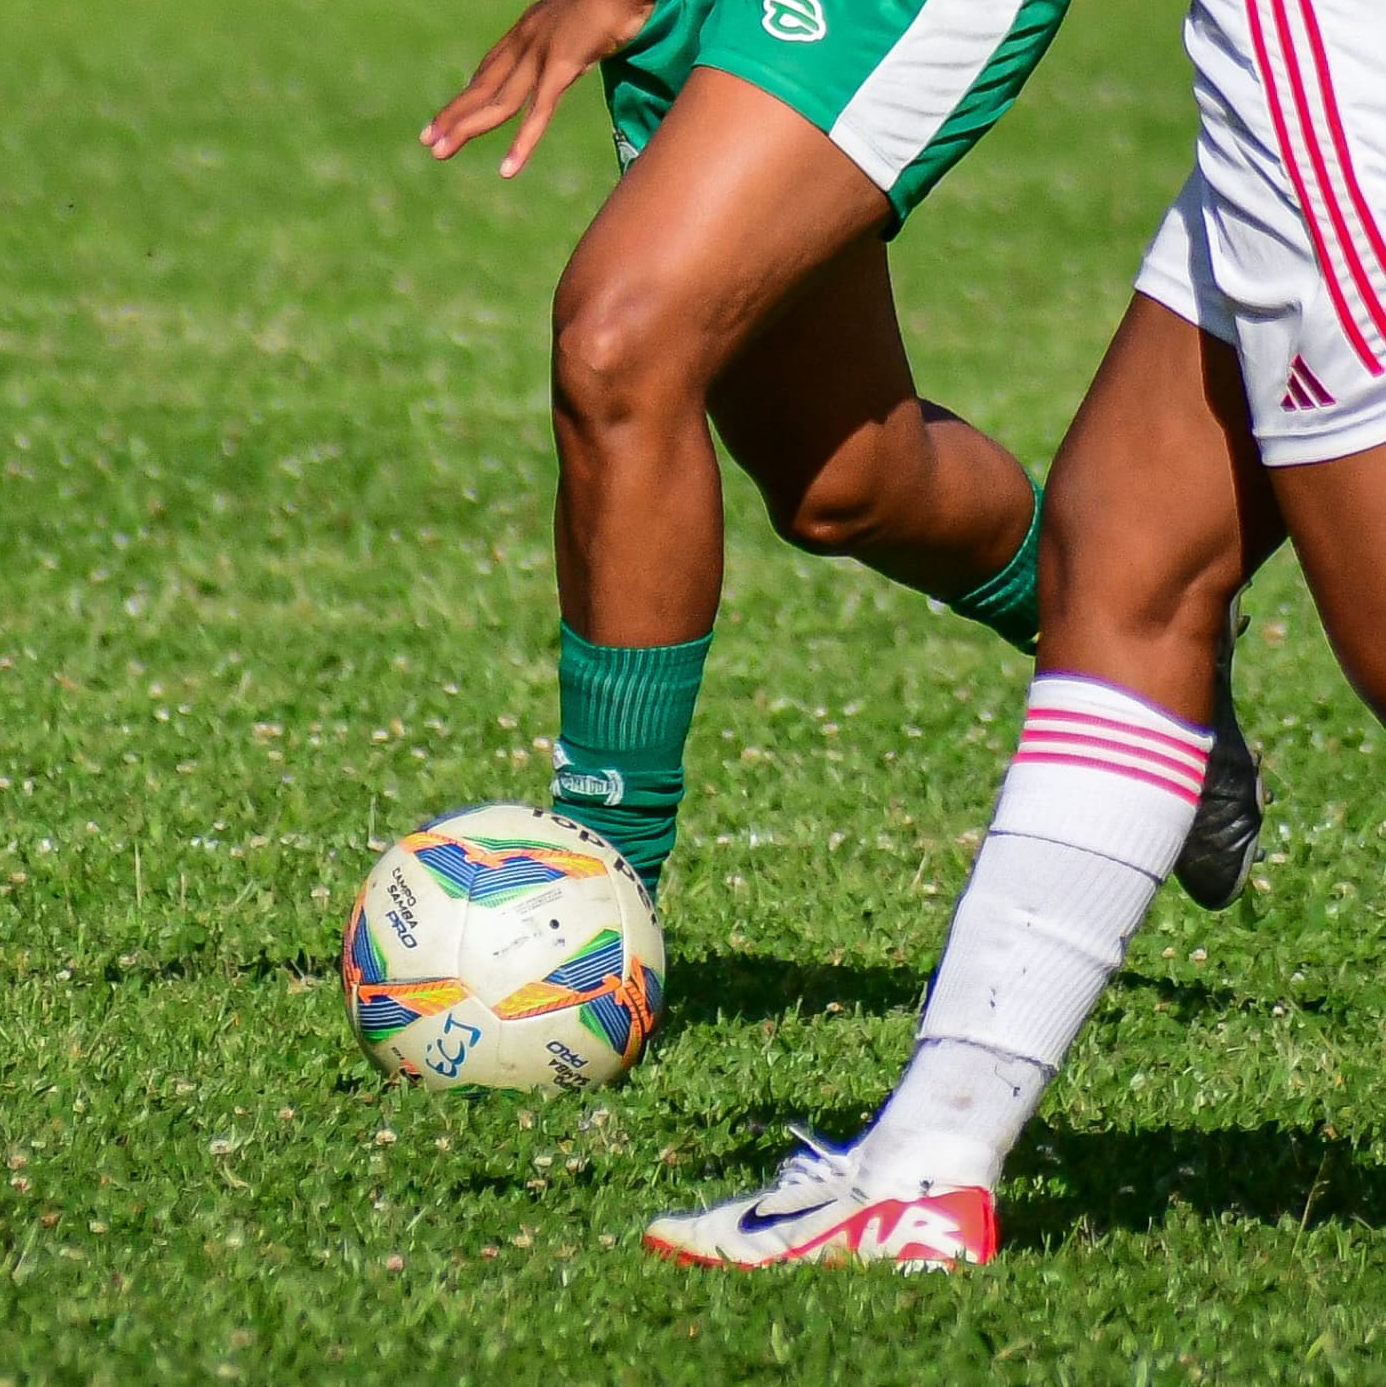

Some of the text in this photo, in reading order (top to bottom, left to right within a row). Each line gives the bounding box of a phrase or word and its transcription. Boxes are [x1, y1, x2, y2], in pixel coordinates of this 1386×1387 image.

[386, 884, 419, 929] SAMBA
[391, 866, 417, 907] CAMPO
[385, 909, 418, 949] PRO
[545, 1040, 590, 1069] PRO
